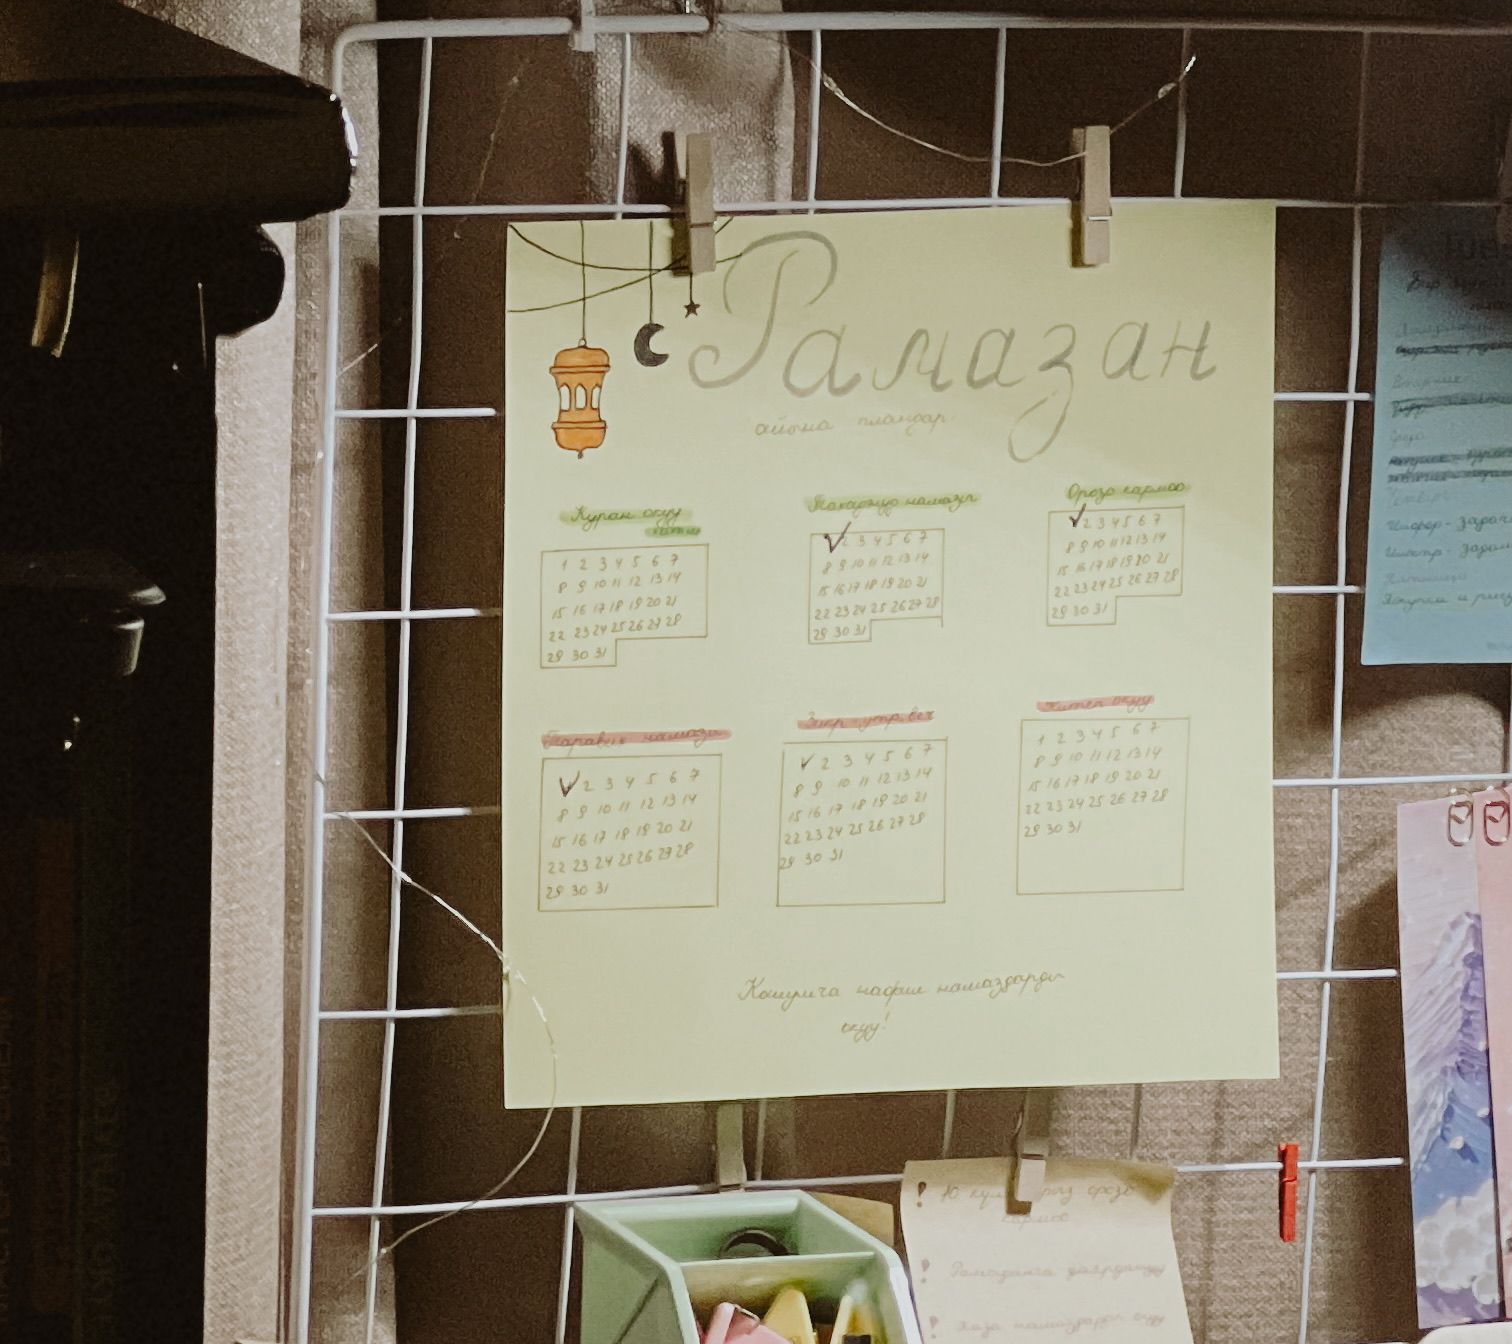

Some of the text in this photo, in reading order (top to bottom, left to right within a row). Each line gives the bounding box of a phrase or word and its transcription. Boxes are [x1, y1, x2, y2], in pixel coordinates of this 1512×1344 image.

[688, 231, 1216, 463] Рамазан
[562, 553, 679, 572] 1 2 3 4 5 6 7
[558, 571, 682, 594] 8 9 10 11 12 13 14
[552, 595, 677, 619] 15 16 17 18 19 20 21
[549, 613, 682, 642] 22 23 24 25 26 27 28
[547, 647, 607, 663] 29 30 31
[1038, 721, 1159, 745] 1 2 3 4 5 6 7
[1034, 747, 1162, 768] 8 9 10 11 12 13 14
[1028, 768, 1161, 792] 15 16 17 18 19 20 21
[1026, 788, 1169, 815] 22 23 24 25 26 27 28
[1024, 821, 1082, 838] 29 30 31
[546, 881, 609, 900] 29 30 31
